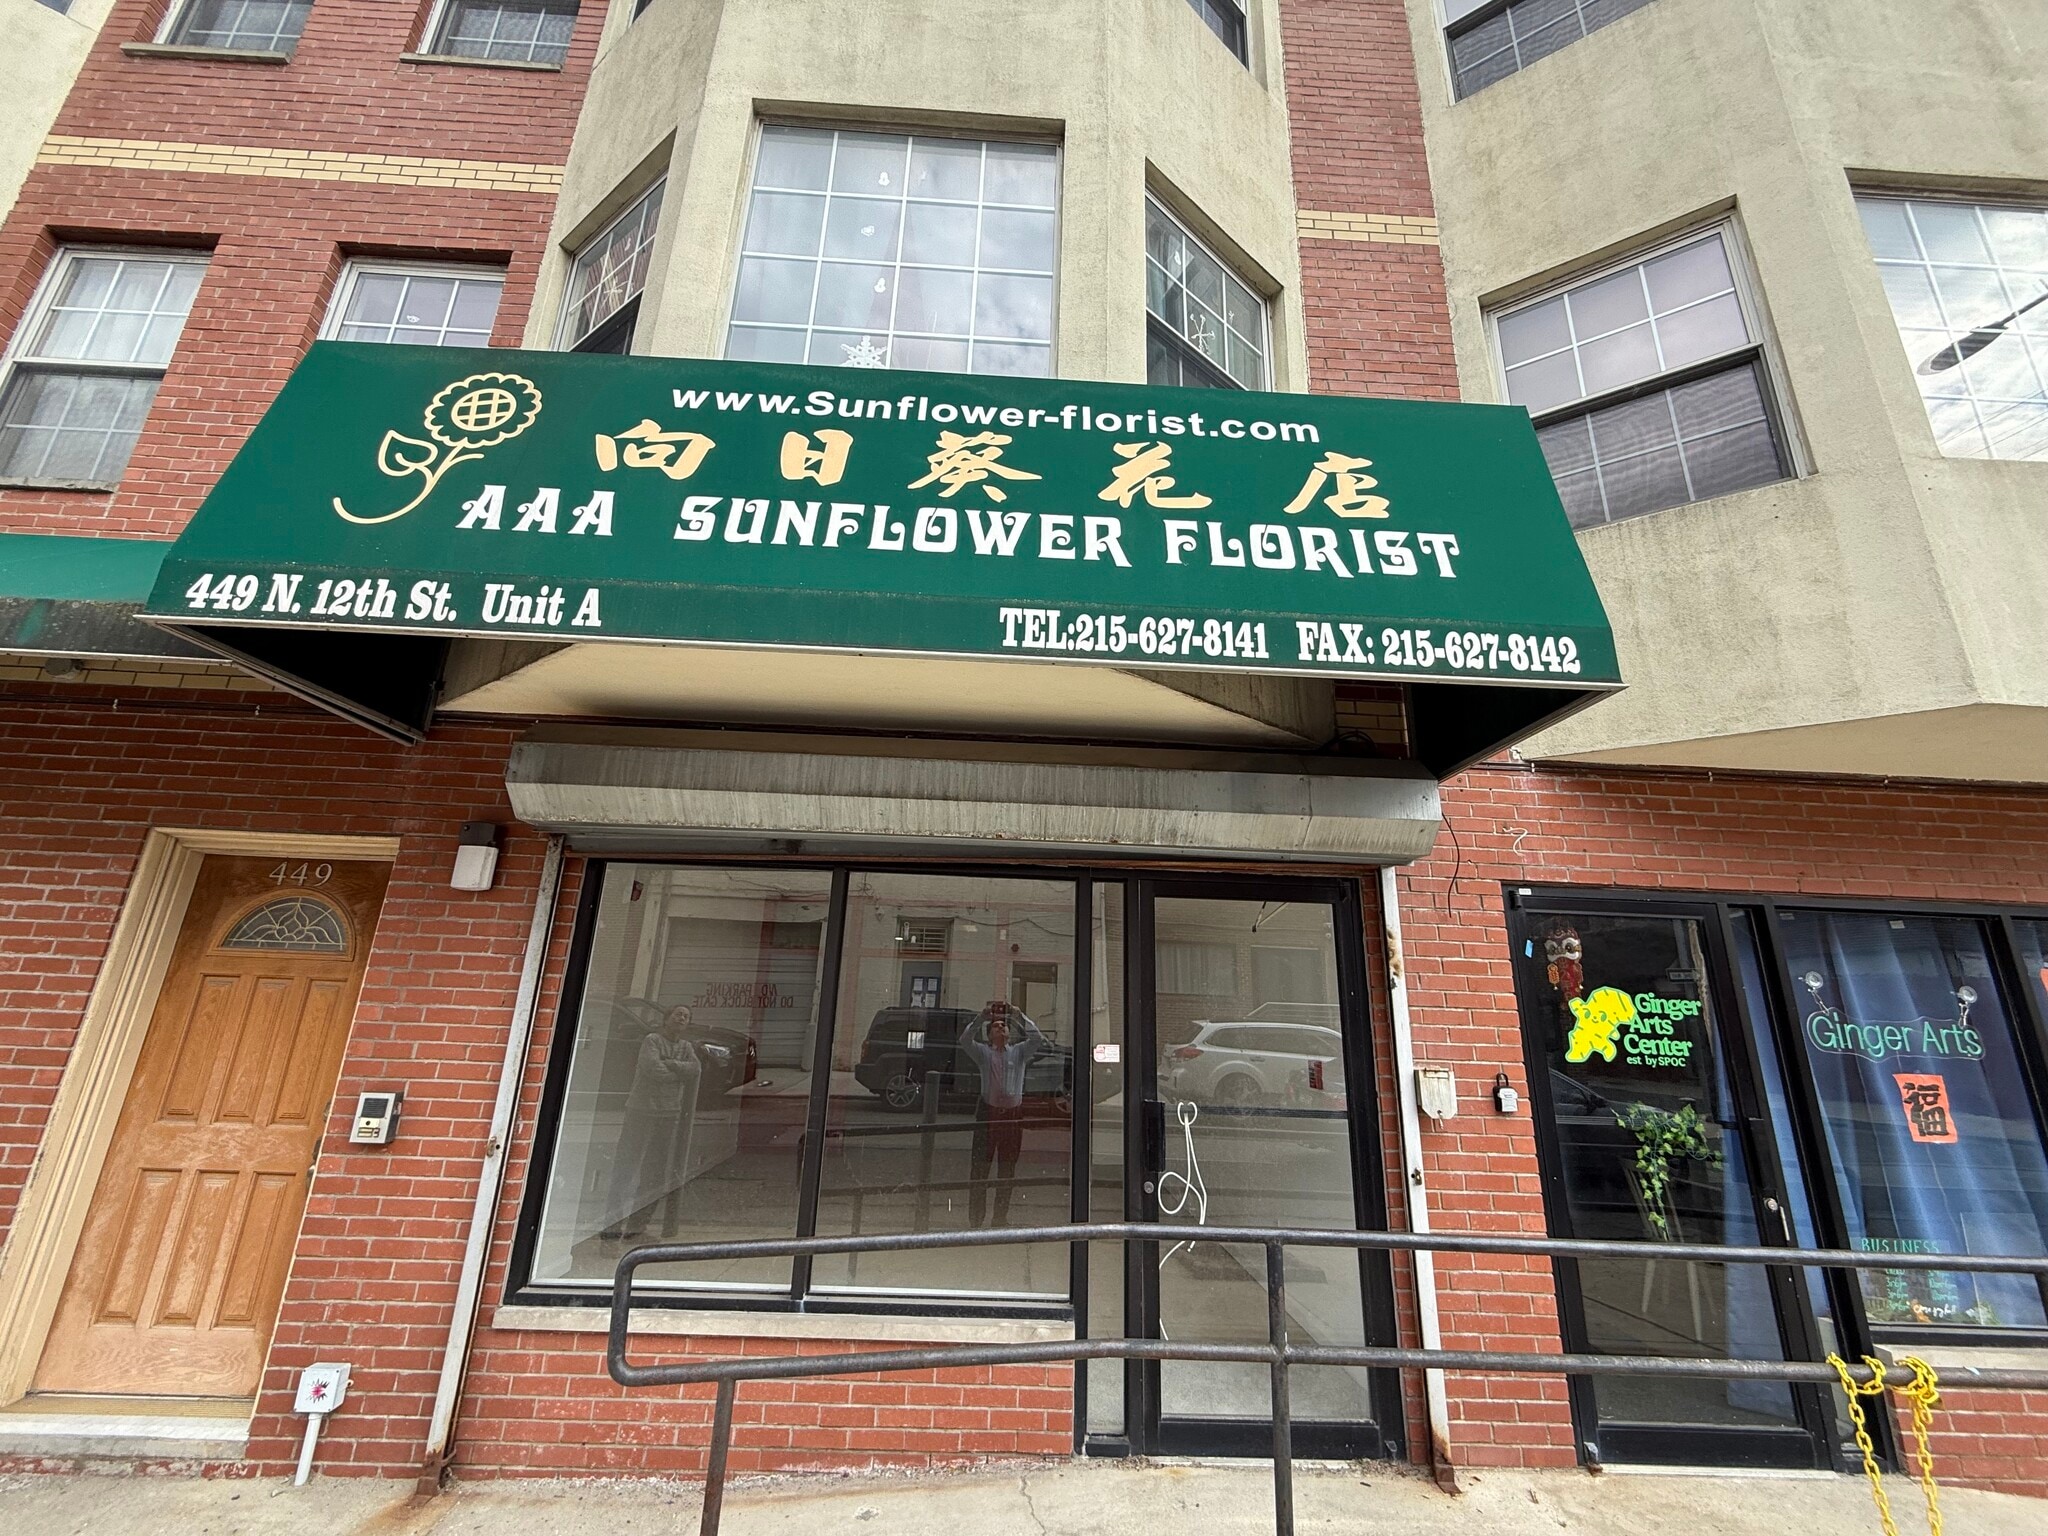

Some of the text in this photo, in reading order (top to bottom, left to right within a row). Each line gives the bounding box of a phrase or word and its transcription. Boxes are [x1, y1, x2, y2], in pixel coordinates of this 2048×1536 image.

[672, 389, 1321, 444] www.Sunflower-florist.com
[597, 419, 1389, 518] 向日葵花店
[674, 495, 1134, 568] SUNFLOWER
[1164, 518, 1460, 578] FLORIST
[185, 573, 602, 627] 449 N. 12th St. Unit A
[1000, 607, 1581, 674] TEL:215-627-8141 FAX: 215-627-8142
[269, 861, 332, 887] 449
[1629, 1015, 1675, 1035] Arts
[1634, 992, 1702, 1021] Ginger
[1623, 1033, 1693, 1057] Center
[1811, 1011, 1983, 1058] Ginger Arts
[1626, 1054, 1687, 1068] est by SPOC
[1903, 1082, 1950, 1136] 福
